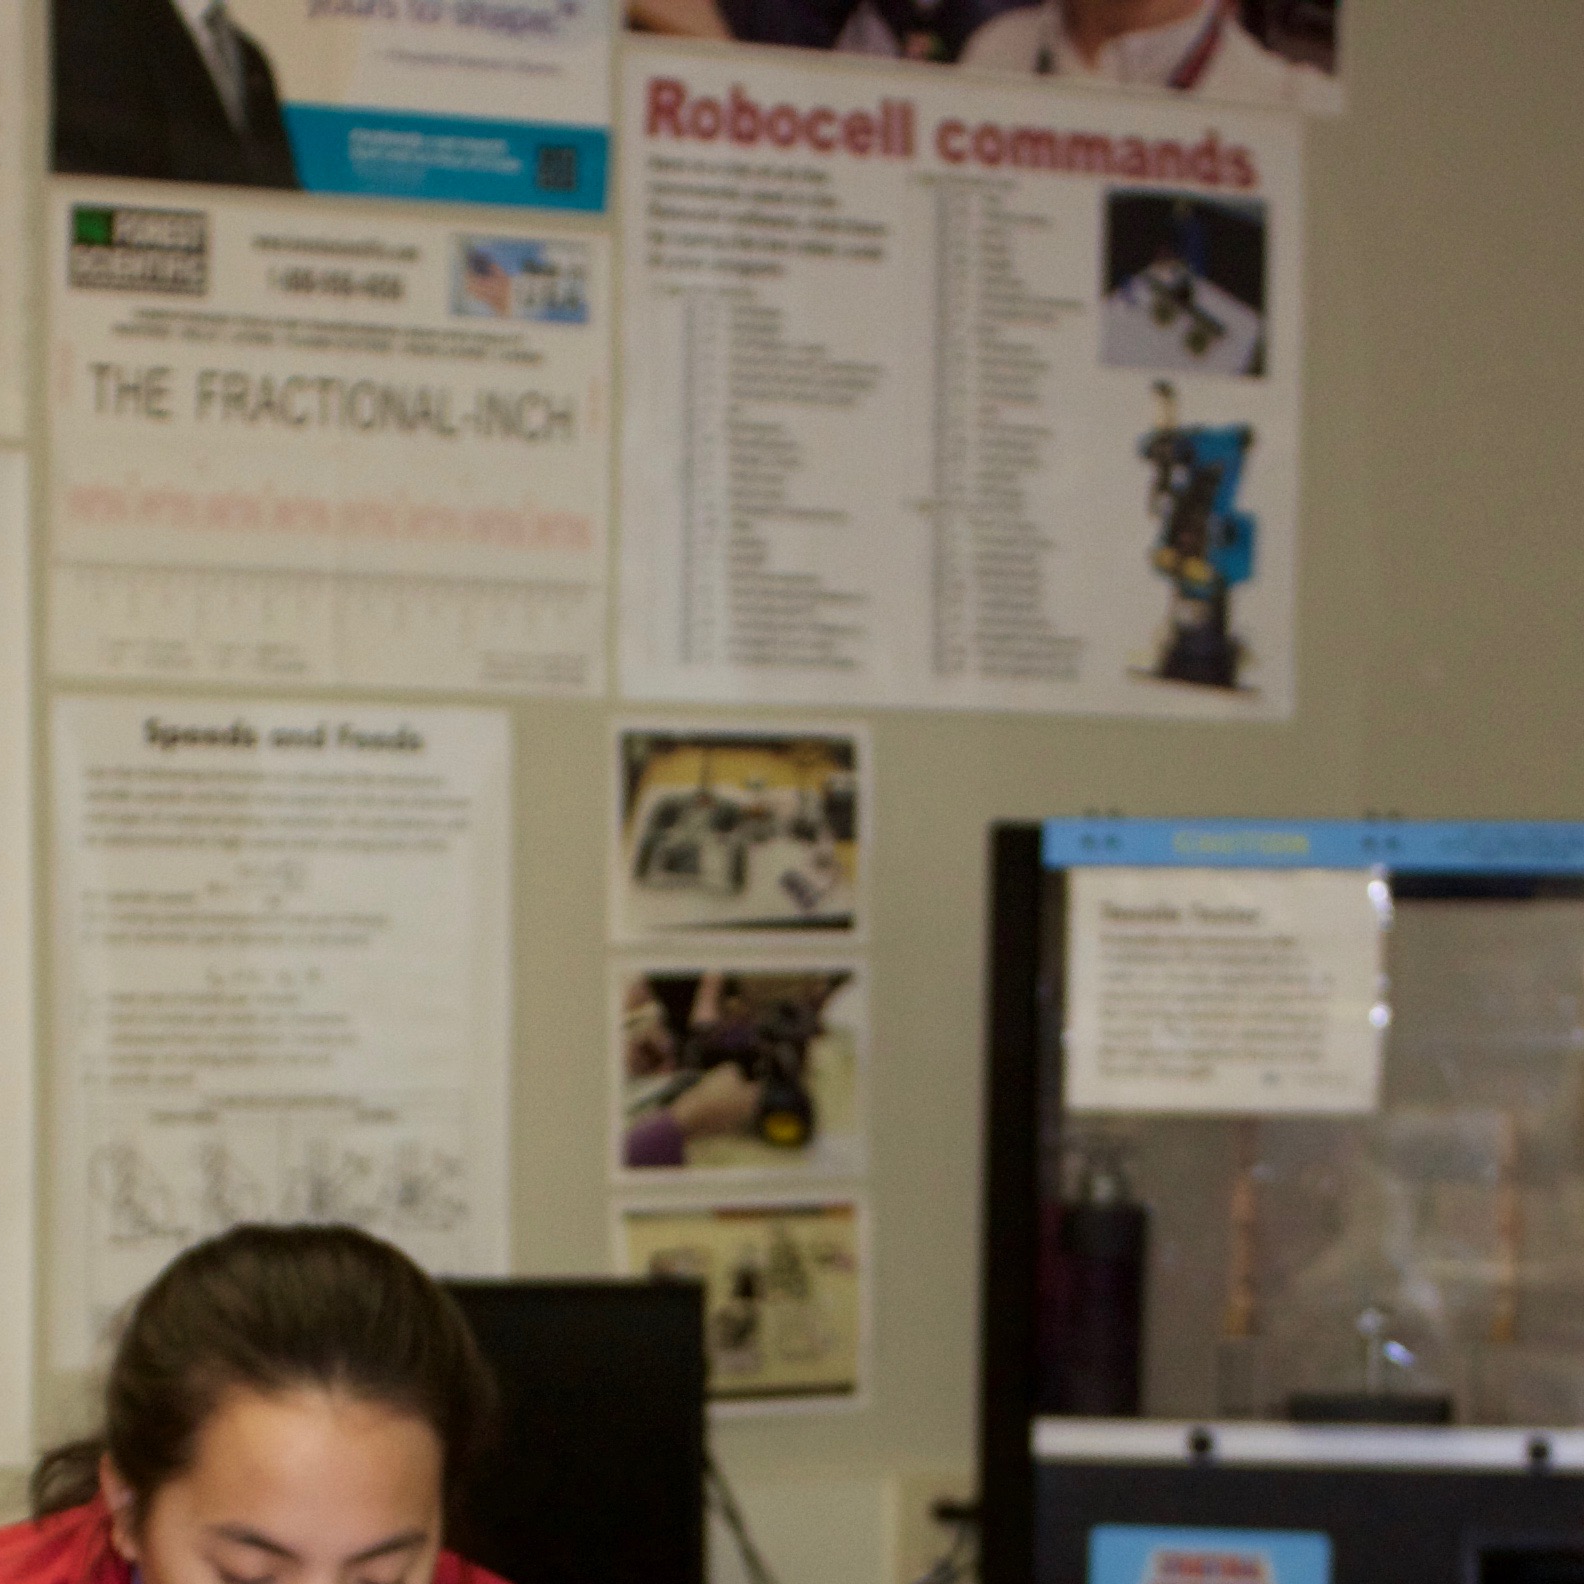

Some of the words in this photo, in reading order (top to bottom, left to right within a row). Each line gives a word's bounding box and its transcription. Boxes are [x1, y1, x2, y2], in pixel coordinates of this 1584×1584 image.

[645, 77, 918, 158] Robocell
[933, 114, 1260, 189] commands
[88, 362, 173, 420] THE
[196, 370, 574, 442] FRACTIONAL-INCH
